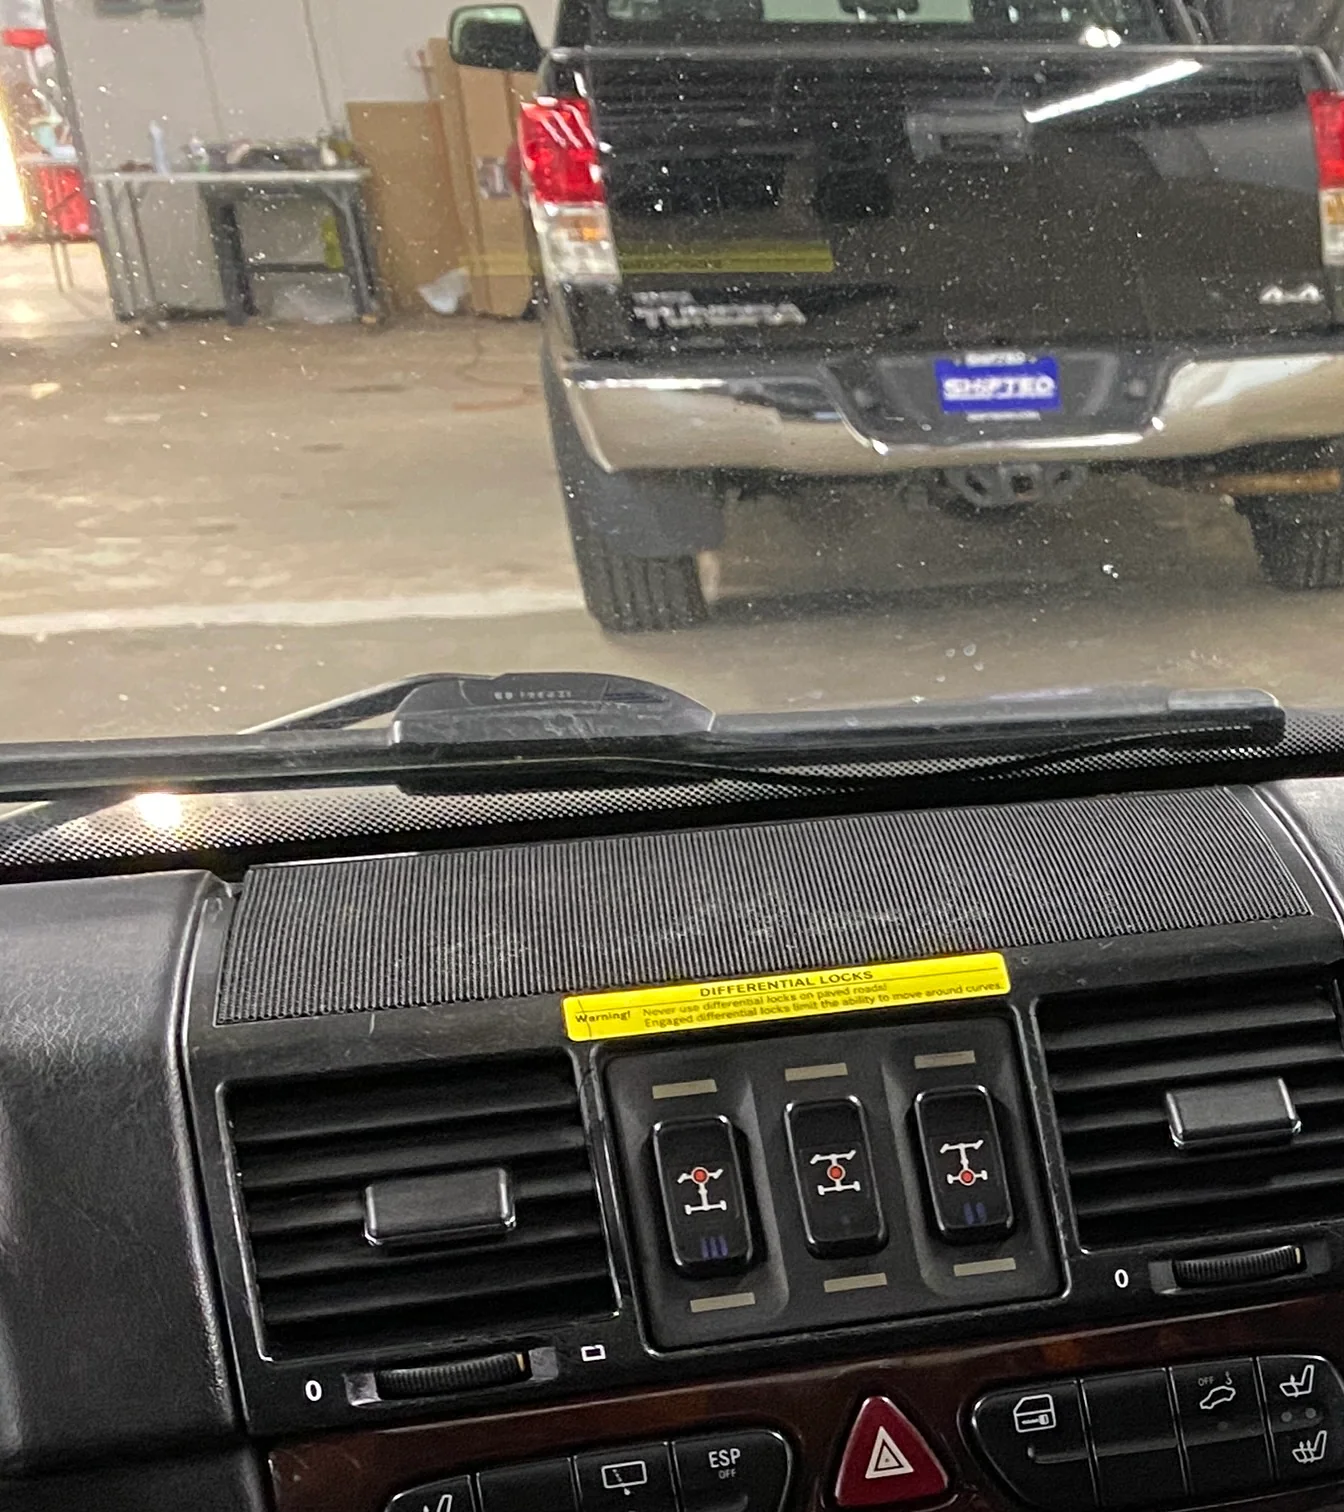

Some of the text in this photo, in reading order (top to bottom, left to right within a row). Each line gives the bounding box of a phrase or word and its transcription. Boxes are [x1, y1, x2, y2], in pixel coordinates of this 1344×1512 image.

[700, 970, 873, 997] DIFFERENTIAL LOCKS
[643, 1006, 676, 1017] Never
[680, 1004, 699, 1013] use
[705, 996, 764, 1011] differential
[766, 993, 796, 1004] locks
[800, 991, 814, 999] on
[817, 987, 850, 1000] paved
[645, 1015, 693, 1028] Engaged
[697, 1008, 758, 1022] differential
[760, 1004, 790, 1016] locks
[793, 1000, 817, 1011] limit
[821, 998, 839, 1008] the
[842, 994, 875, 1008] ability
[878, 992, 890, 1002] to
[892, 991, 922, 1001] move
[925, 985, 963, 997] around
[575, 1010, 631, 1024] Warning!
[1113, 1267, 1129, 1289] 0
[304, 1379, 323, 1402] 0
[708, 1447, 741, 1469] ESP
[718, 1468, 737, 1480] OFF
